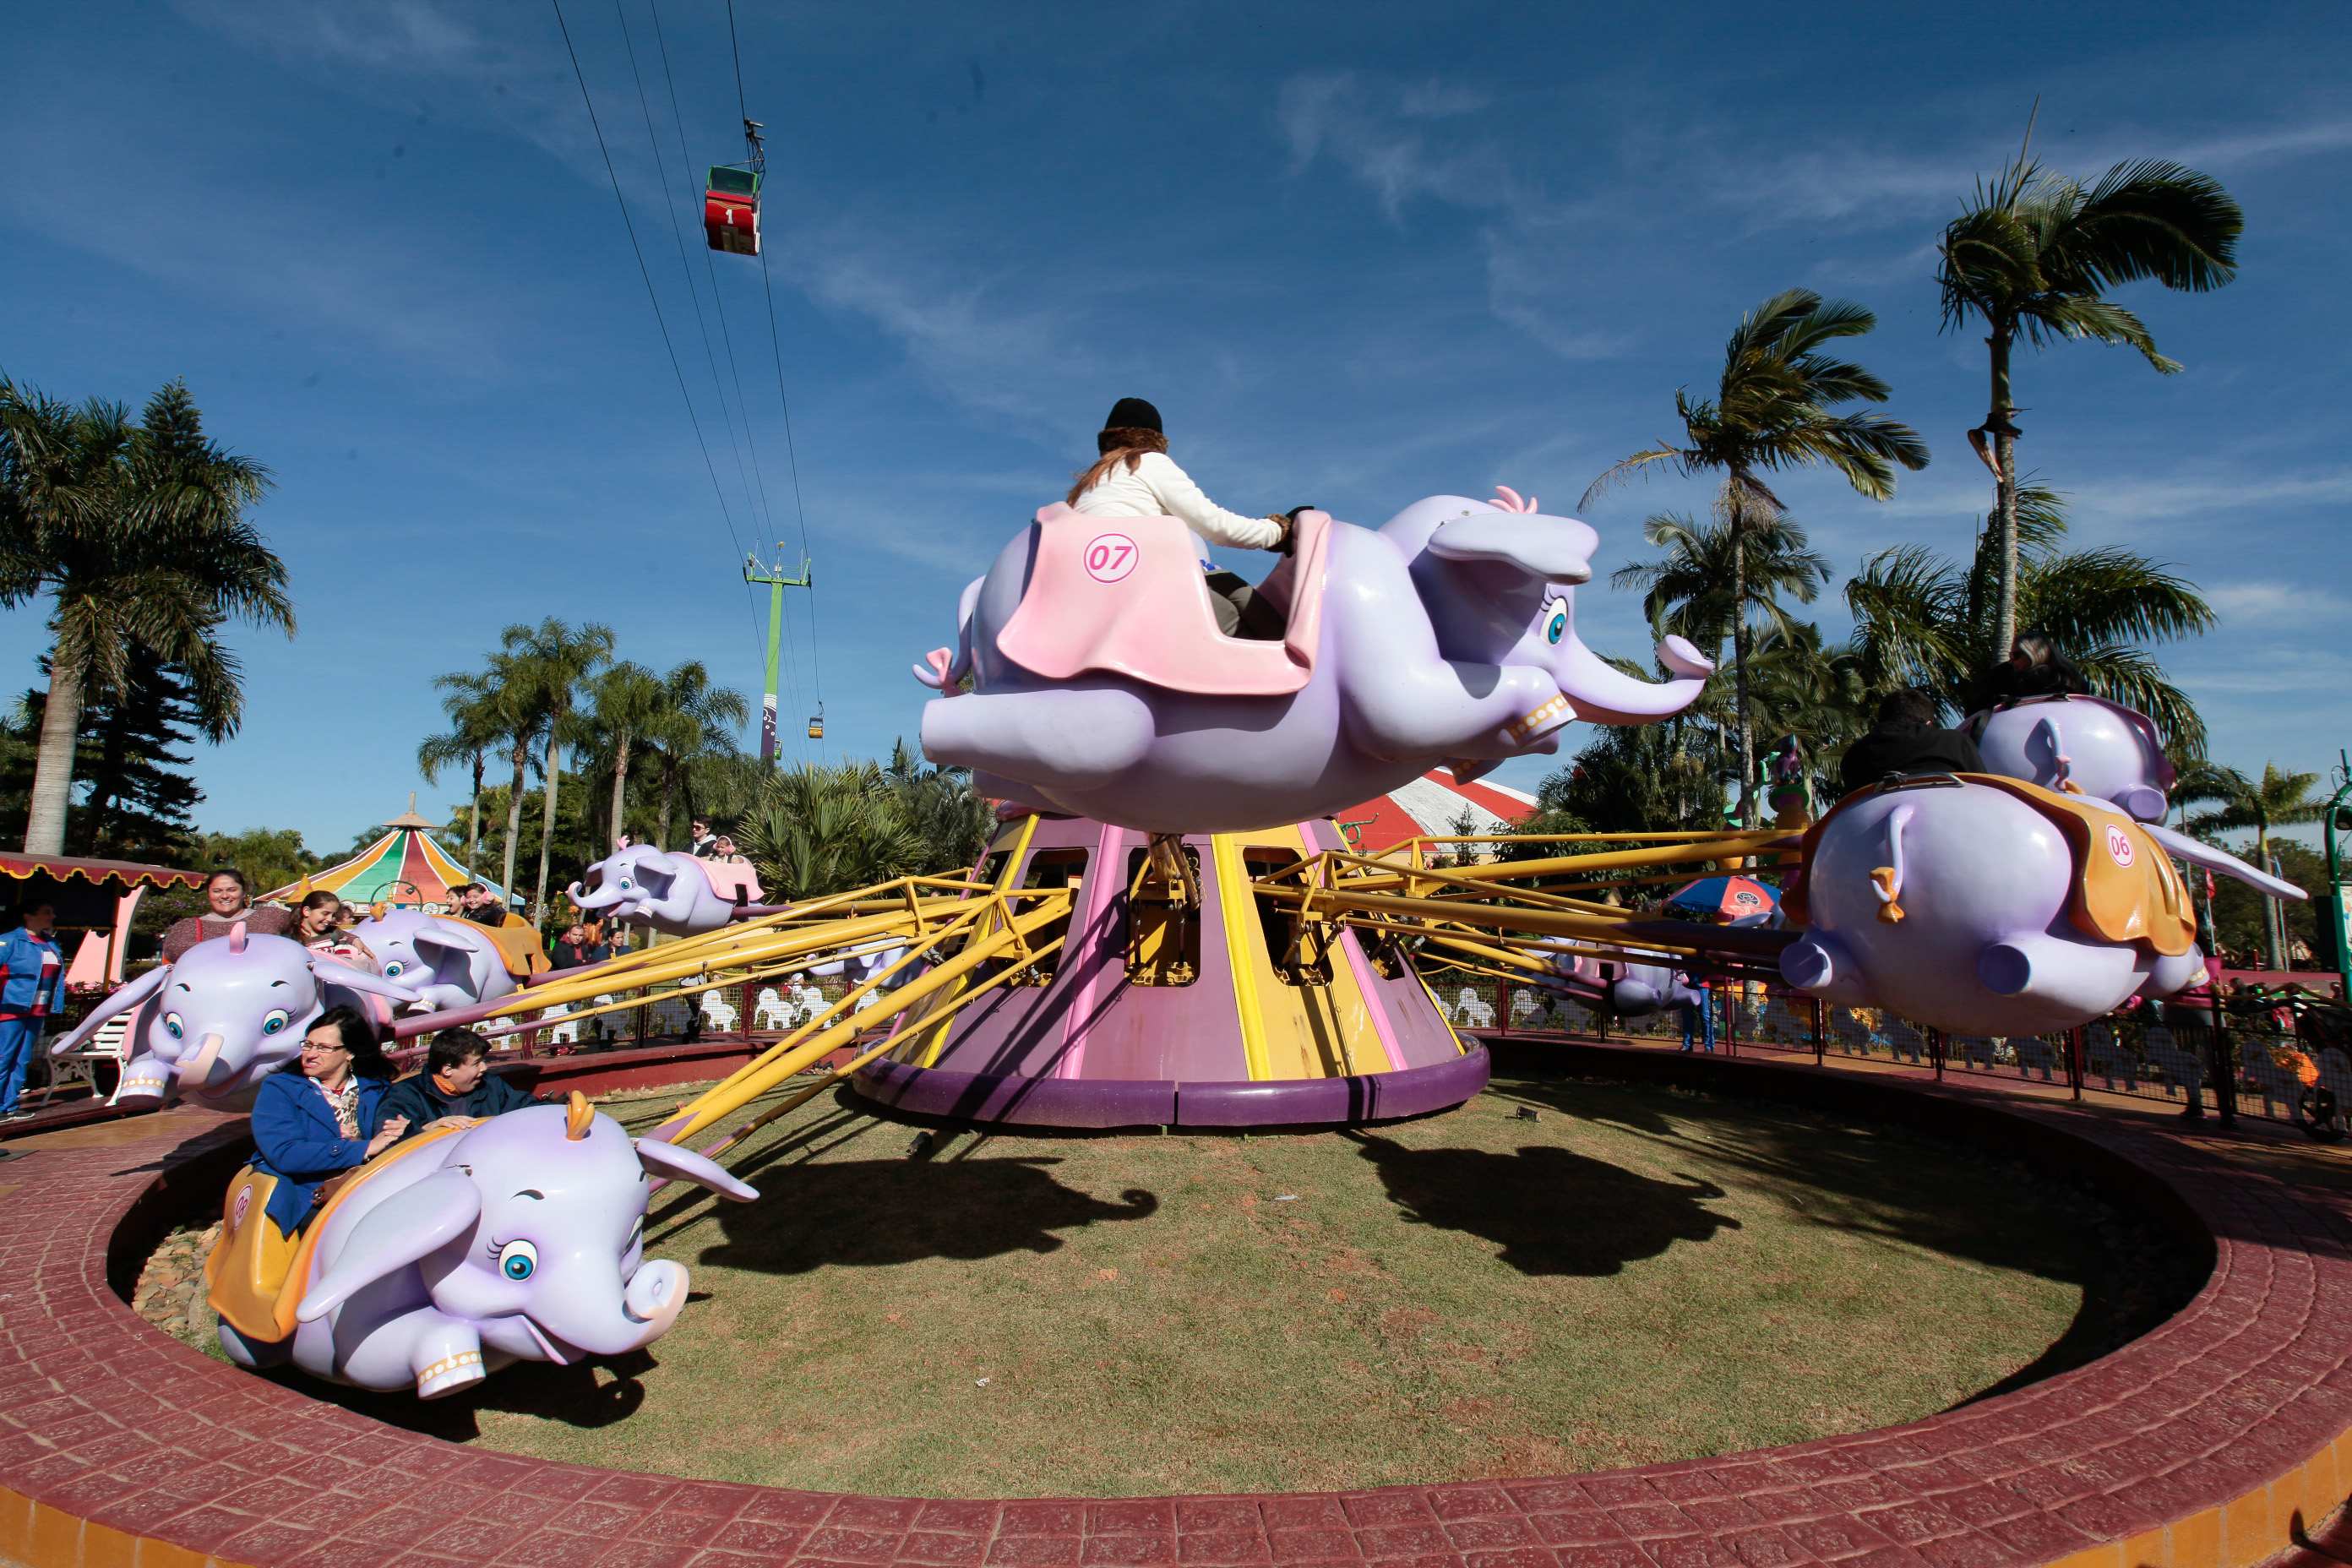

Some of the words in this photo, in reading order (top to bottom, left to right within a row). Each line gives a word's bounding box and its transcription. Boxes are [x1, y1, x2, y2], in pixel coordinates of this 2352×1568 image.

[725, 209, 734, 225] 1
[1089, 545, 1133, 570] 07
[2110, 836, 2130, 856] 06
[236, 1195, 248, 1219] 08
